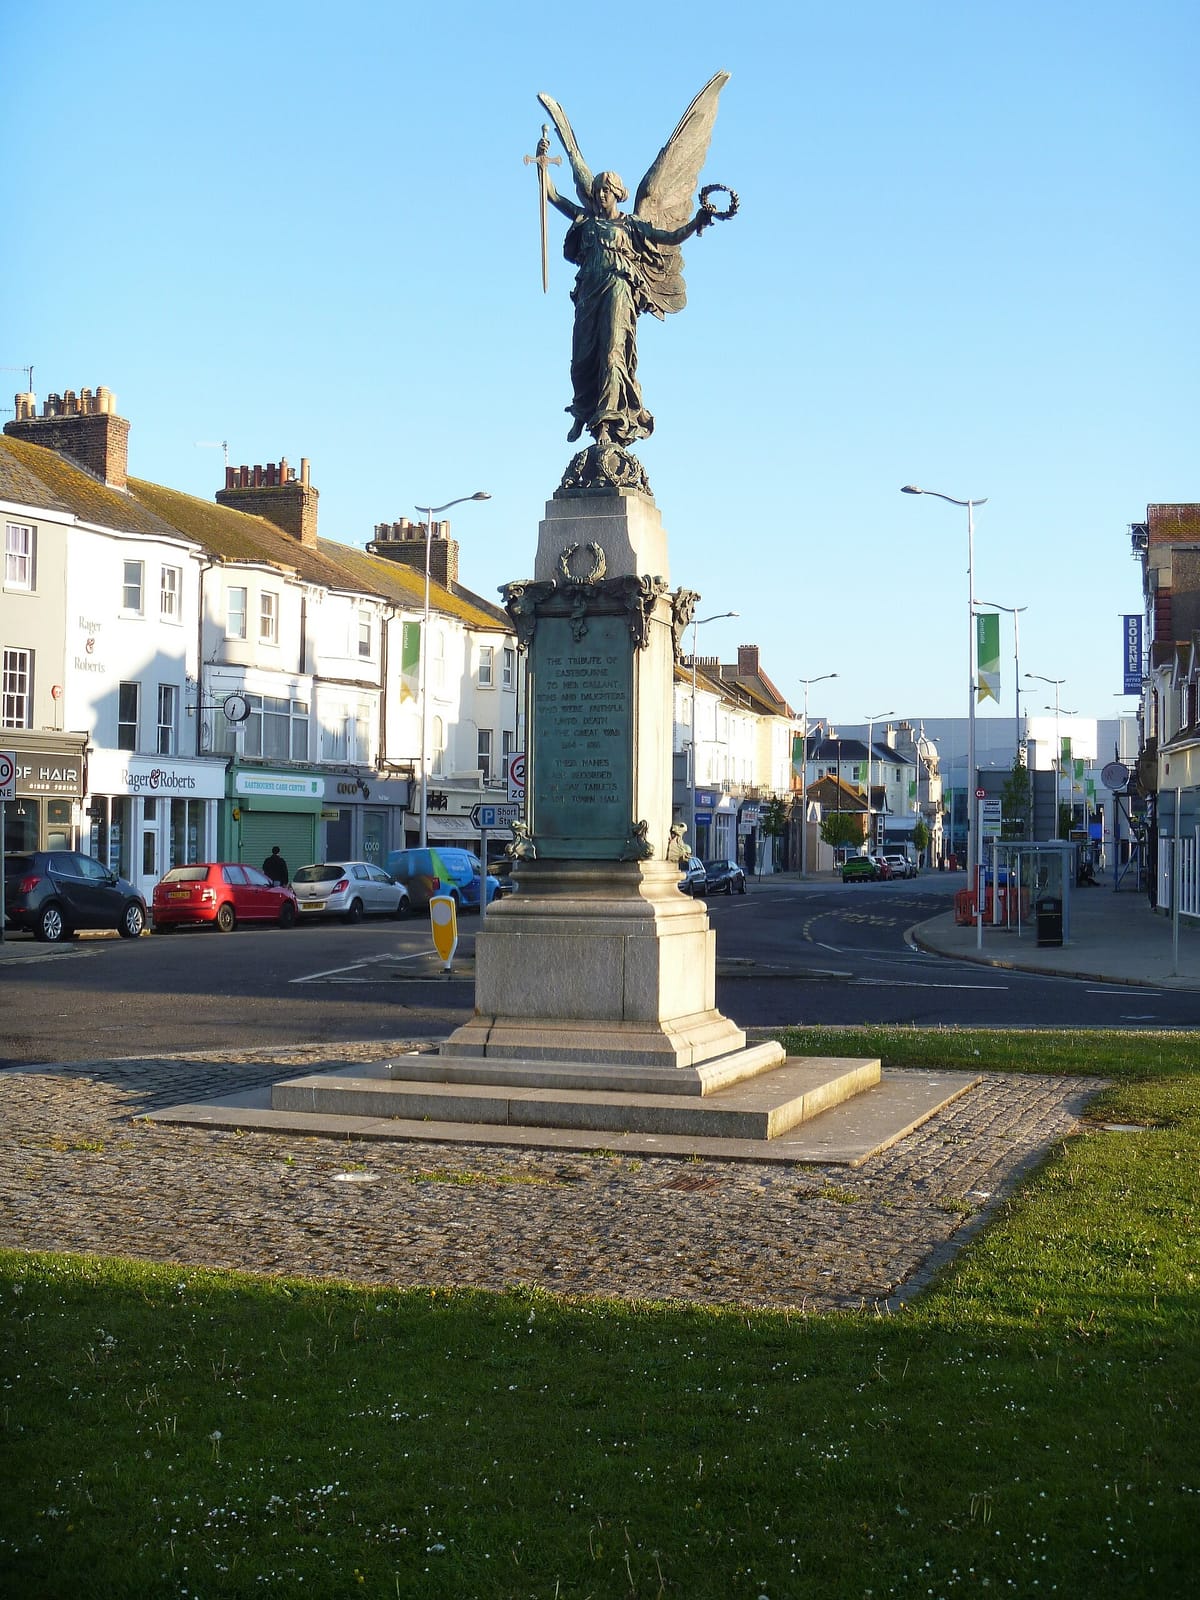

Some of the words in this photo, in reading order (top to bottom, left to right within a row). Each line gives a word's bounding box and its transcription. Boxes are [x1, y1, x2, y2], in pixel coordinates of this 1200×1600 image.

[79, 616, 102, 635] Rager
[86, 638, 95, 654] &
[1128, 618, 1138, 672] BOURNE
[74, 656, 106, 673] Roberts
[568, 656, 602, 664] TRIBUTE
[40, 767, 78, 782] HAIR
